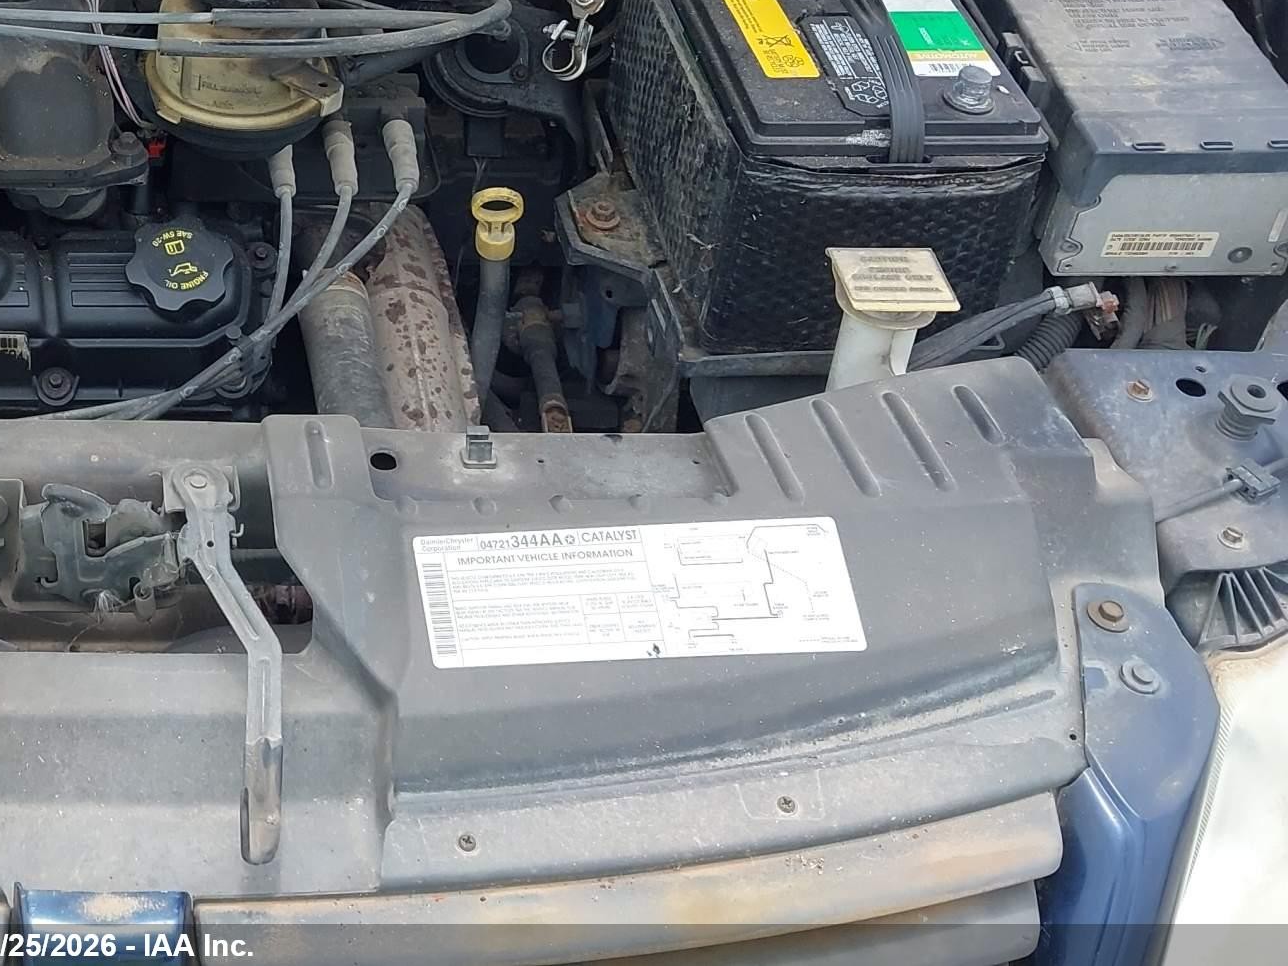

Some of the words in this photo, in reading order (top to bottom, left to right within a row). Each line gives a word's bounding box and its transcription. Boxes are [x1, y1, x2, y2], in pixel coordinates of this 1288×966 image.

[152, 231, 175, 247] 5W-20
[176, 230, 194, 240] SAE
[164, 279, 178, 290] OIL
[180, 270, 209, 290] ENGINE
[420, 537, 474, 546] DaimlerChrysler
[479, 532, 563, 550] 04721344AA
[581, 529, 638, 543] CATALYST
[457, 554, 516, 566] IMPORTANT
[517, 552, 559, 562] VEHICLE
[561, 548, 633, 561] INFORMATION
